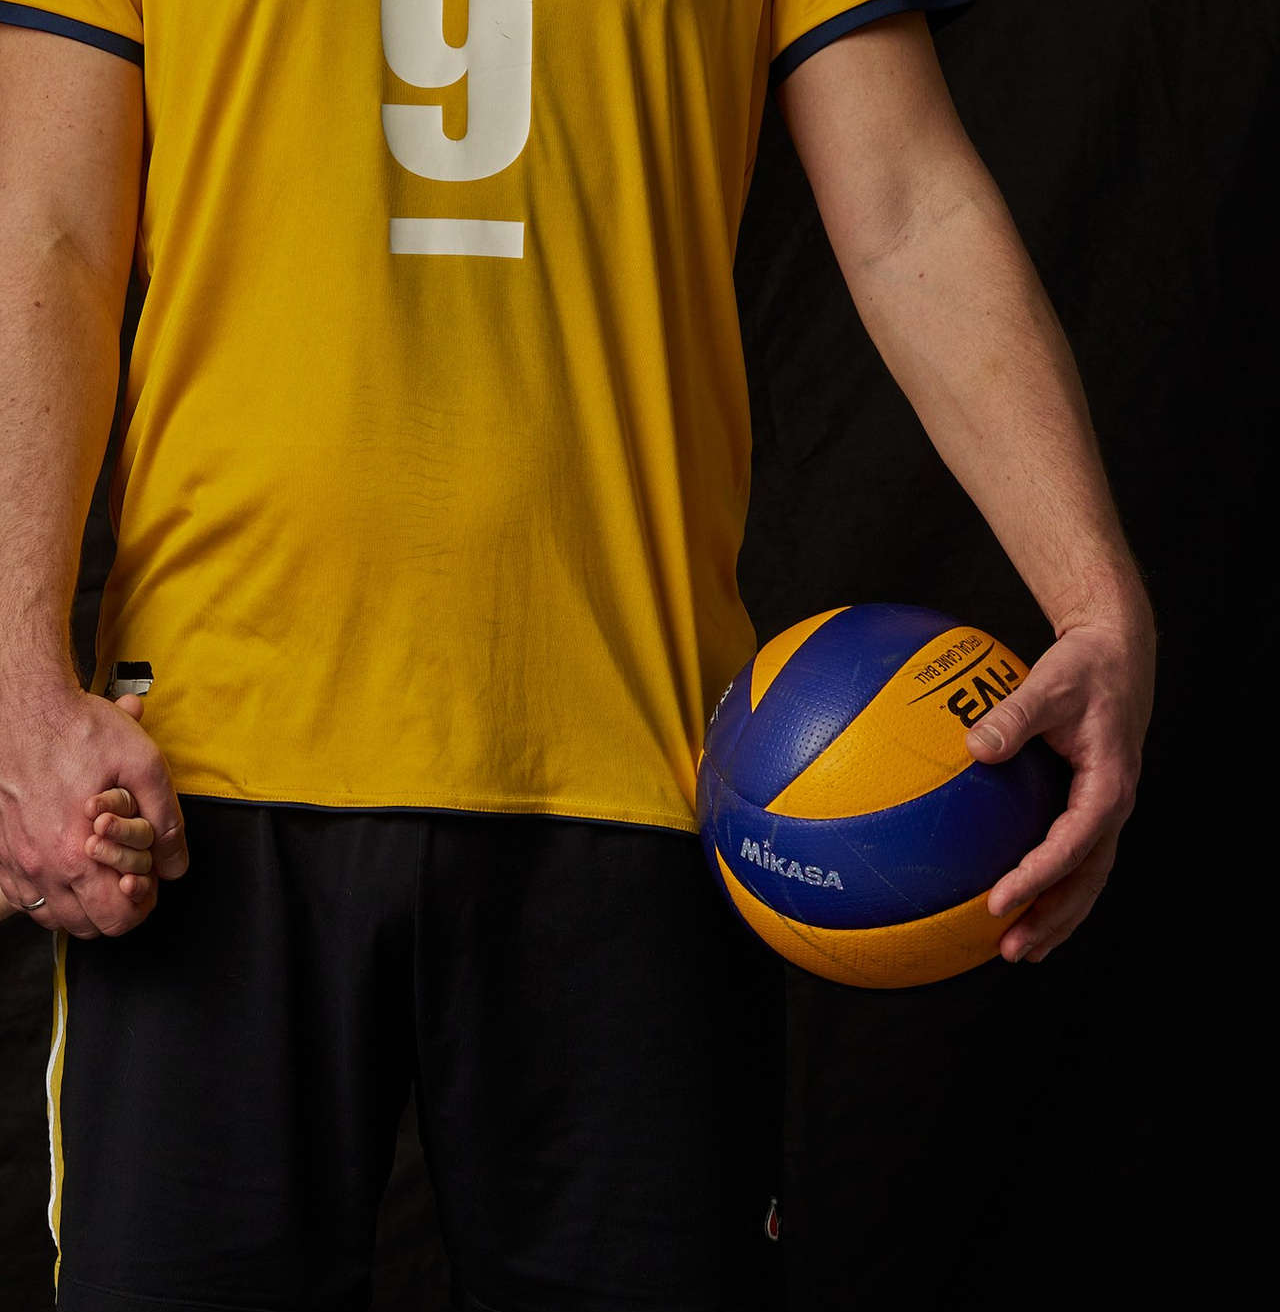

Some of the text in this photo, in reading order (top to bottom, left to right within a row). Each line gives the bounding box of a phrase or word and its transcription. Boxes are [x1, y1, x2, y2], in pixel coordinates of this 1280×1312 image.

[933, 649, 963, 672] GAME
[913, 664, 941, 685] BALL
[947, 658, 1021, 729] FIVB
